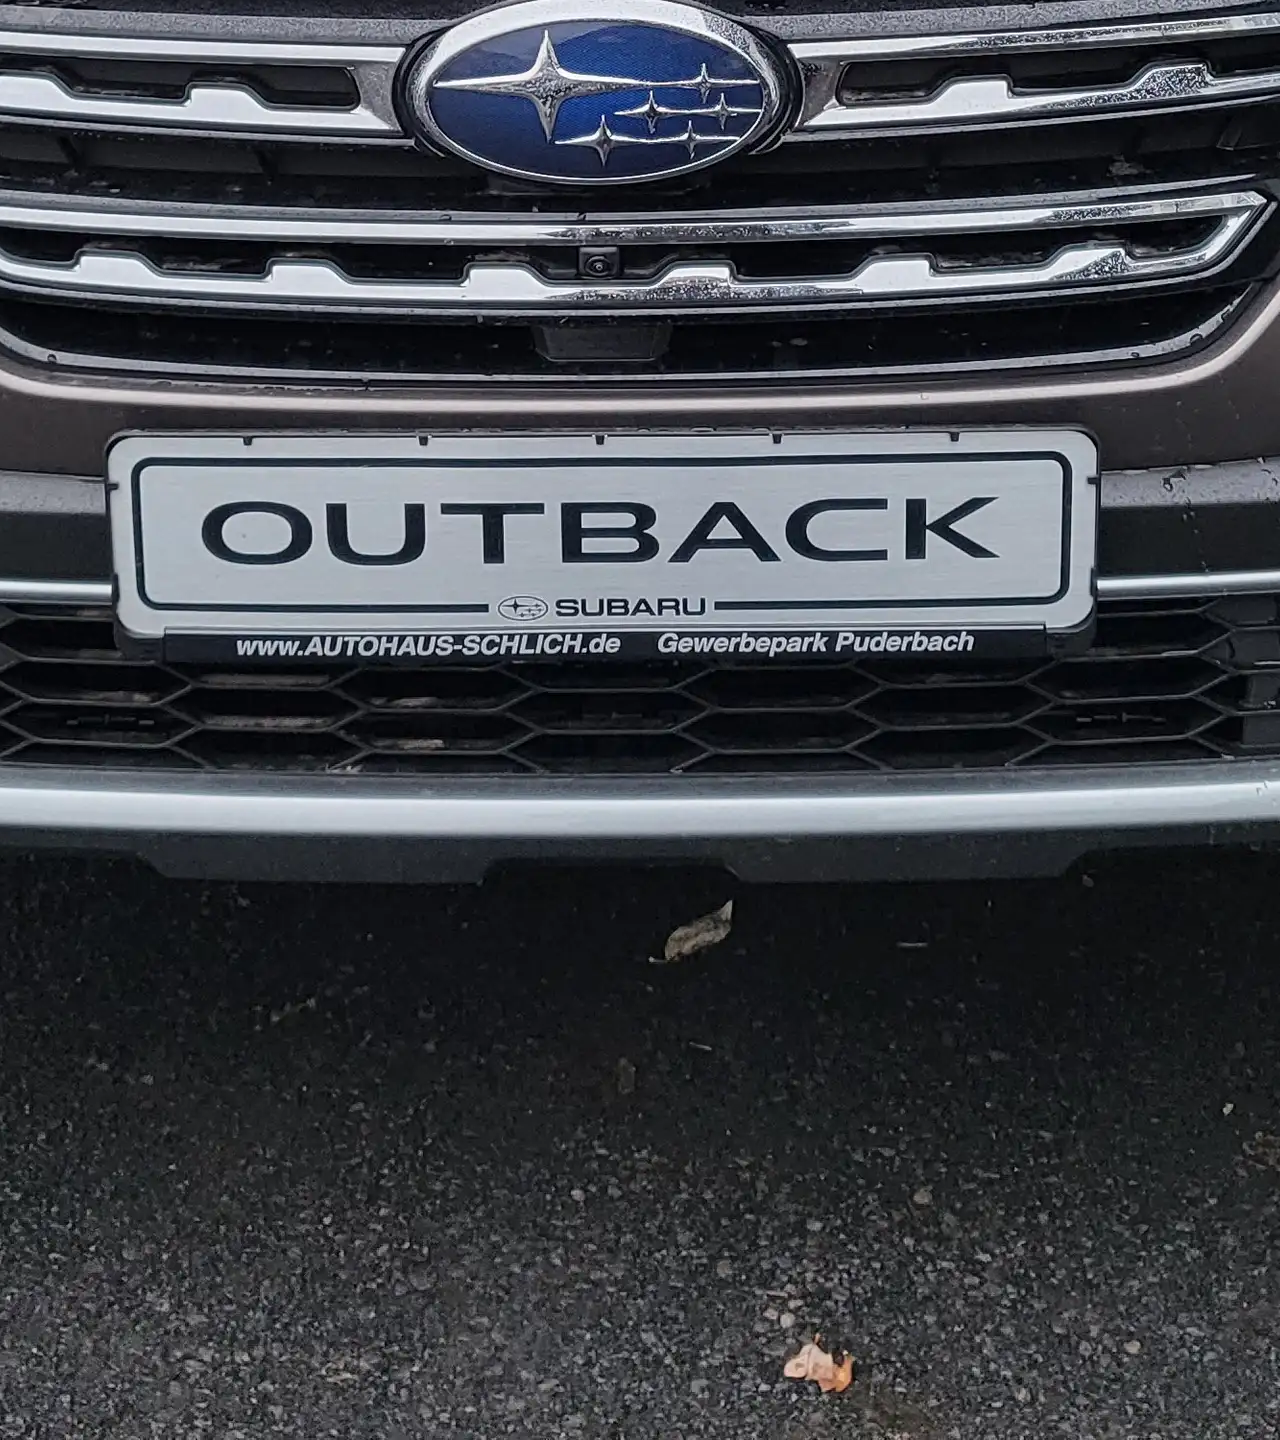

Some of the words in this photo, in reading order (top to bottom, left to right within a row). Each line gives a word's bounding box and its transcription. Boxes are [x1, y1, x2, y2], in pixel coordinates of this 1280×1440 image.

[201, 496, 1001, 566] OUTBACK
[555, 597, 706, 617] SUBARU
[236, 633, 621, 657] www.AUTOHAUS-SCHLICH.de
[658, 631, 827, 657] Gewerbepark
[835, 630, 975, 653] Puderbach
